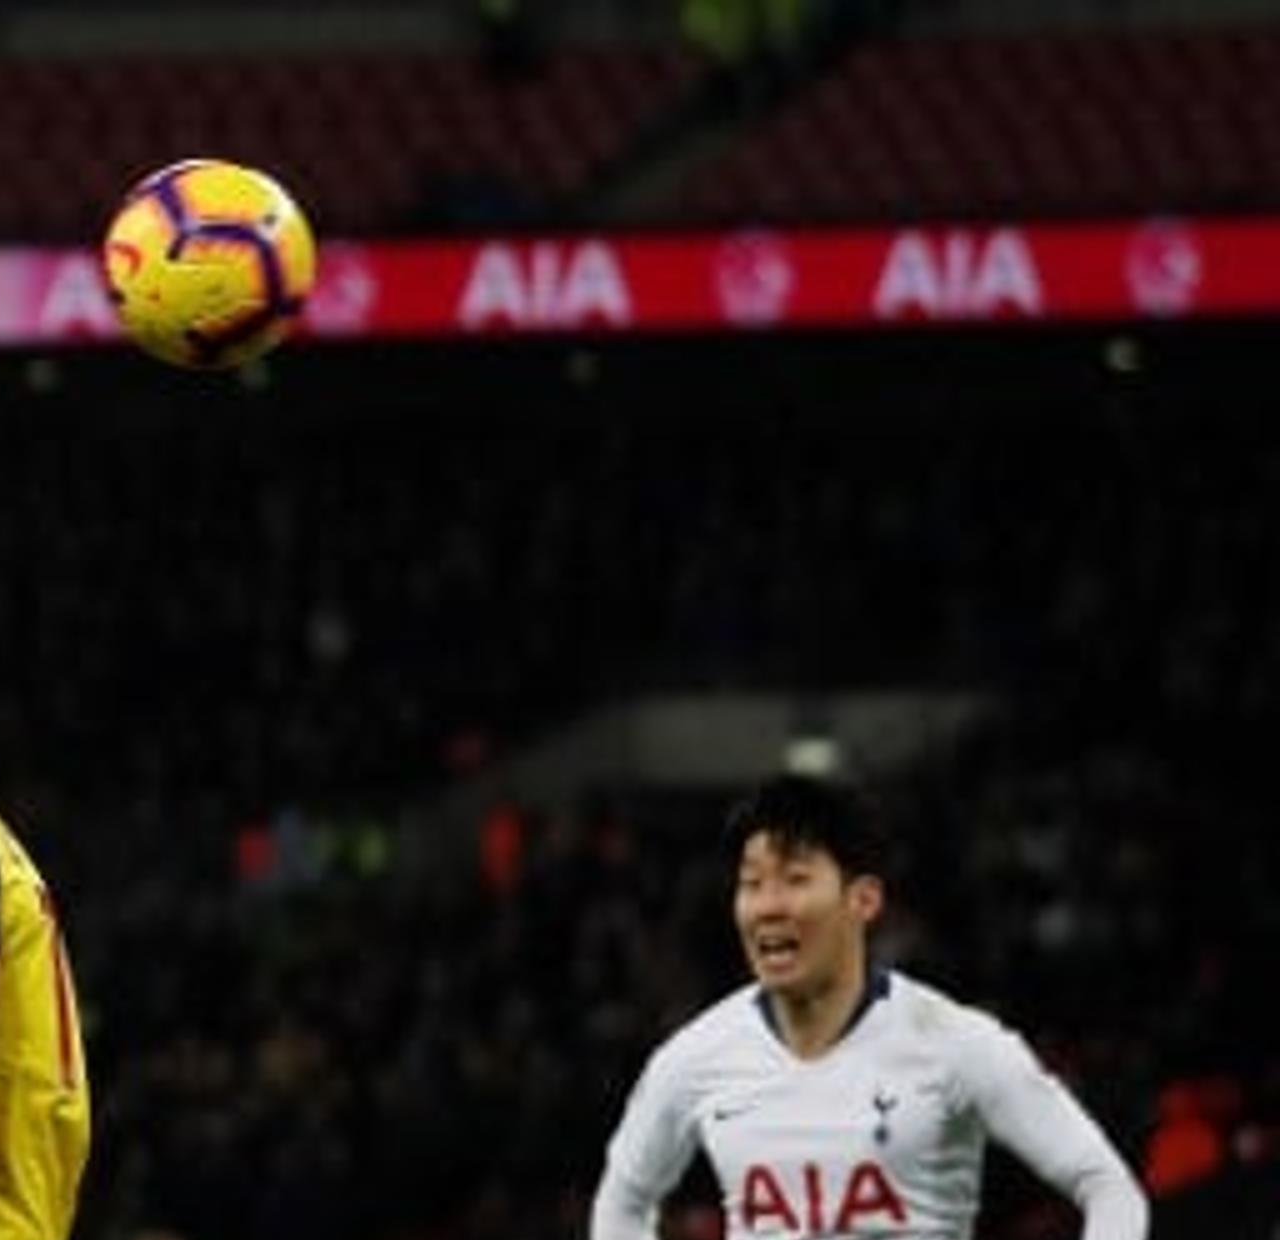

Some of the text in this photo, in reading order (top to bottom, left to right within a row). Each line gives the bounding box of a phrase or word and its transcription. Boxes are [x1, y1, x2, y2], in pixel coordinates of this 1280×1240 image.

[458, 238, 634, 330] AIA
[871, 228, 1042, 320] AIA
[740, 1161, 908, 1234] AIA
